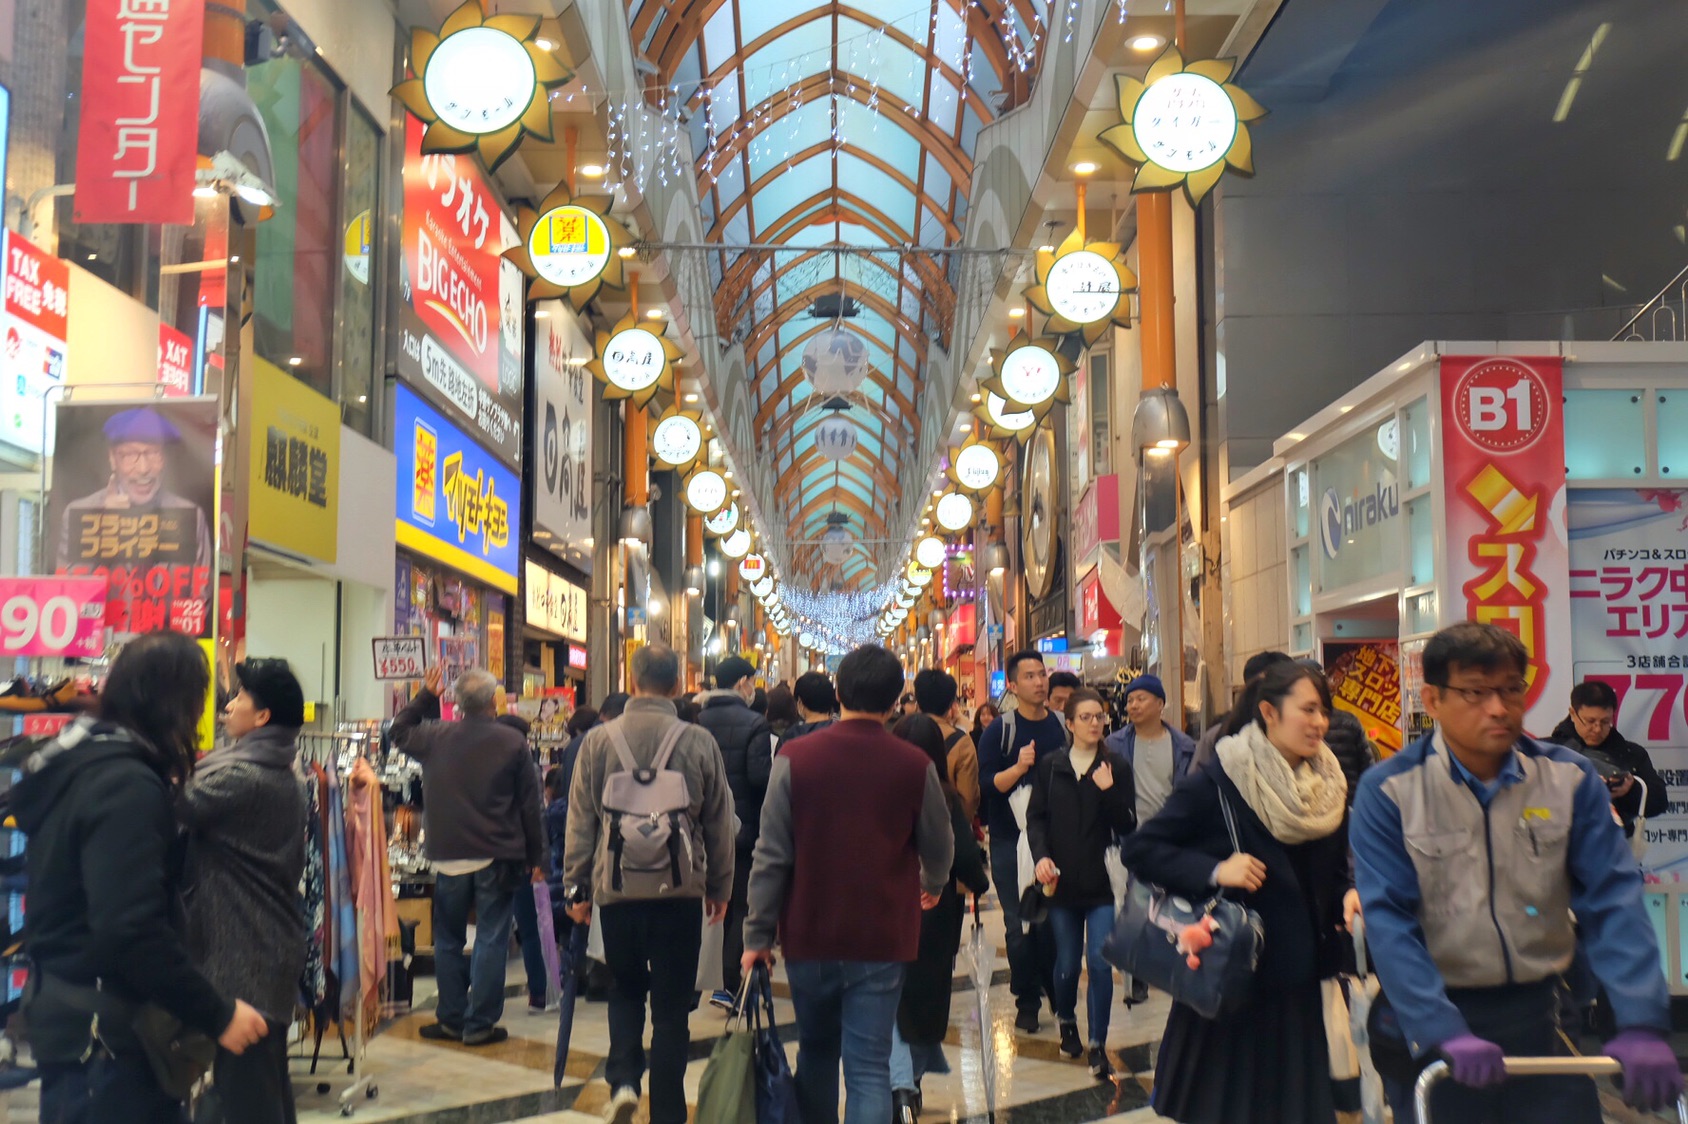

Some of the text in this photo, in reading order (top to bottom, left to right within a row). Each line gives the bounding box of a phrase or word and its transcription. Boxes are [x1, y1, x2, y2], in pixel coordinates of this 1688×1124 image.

[11, 247, 41, 286] TAX
[6, 273, 42, 316] FREE
[417, 227, 488, 354] BIG ECHO
[1469, 379, 1532, 431] B1
[81, 514, 159, 536] ブラック
[1344, 482, 1399, 536] niraku
[80, 535, 180, 559] フライデー
